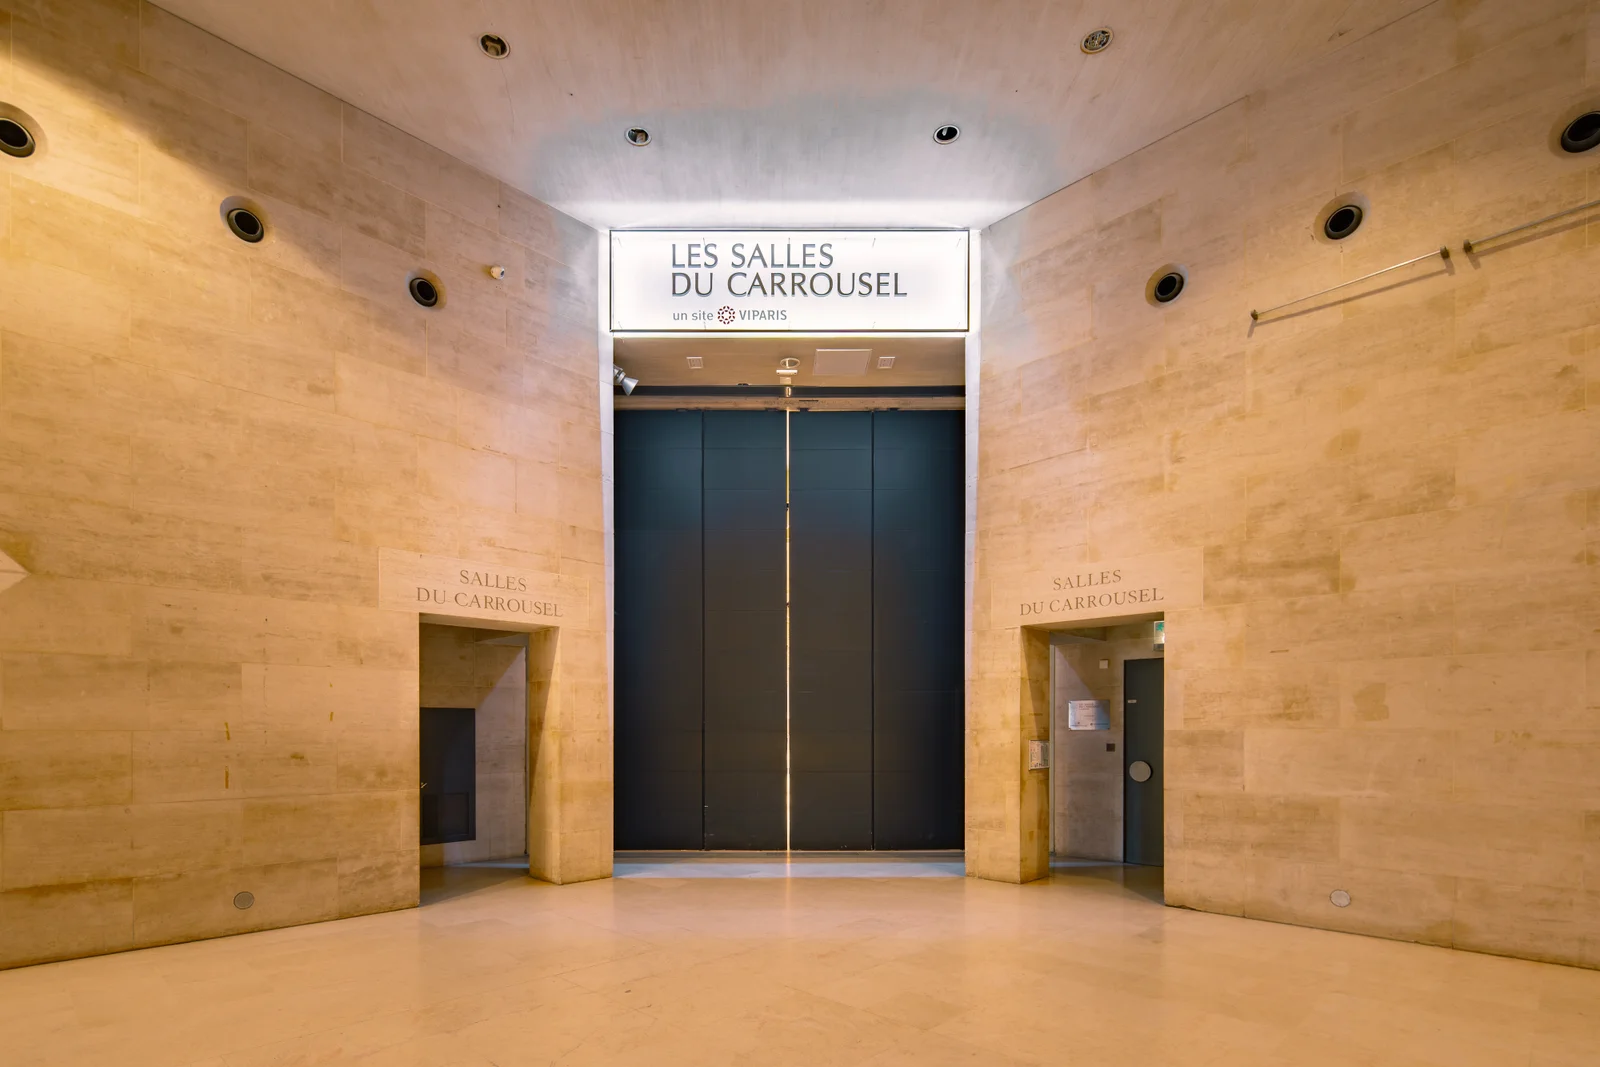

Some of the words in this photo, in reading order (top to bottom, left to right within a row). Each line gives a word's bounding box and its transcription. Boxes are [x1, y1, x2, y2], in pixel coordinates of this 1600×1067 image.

[672, 243, 718, 269] LES
[731, 243, 834, 269] SALLES
[672, 272, 713, 297] DU
[727, 271, 908, 297] CARROUSEL
[672, 311, 688, 321] un
[691, 309, 714, 321] site
[739, 309, 788, 321] VIPARIS
[459, 569, 527, 592] SALLES
[1053, 569, 1122, 591] SALLES
[416, 586, 446, 604] DU
[454, 592, 563, 617] CARROUSEL
[1020, 601, 1044, 616] DU
[1049, 587, 1164, 613] CARROUSEL
